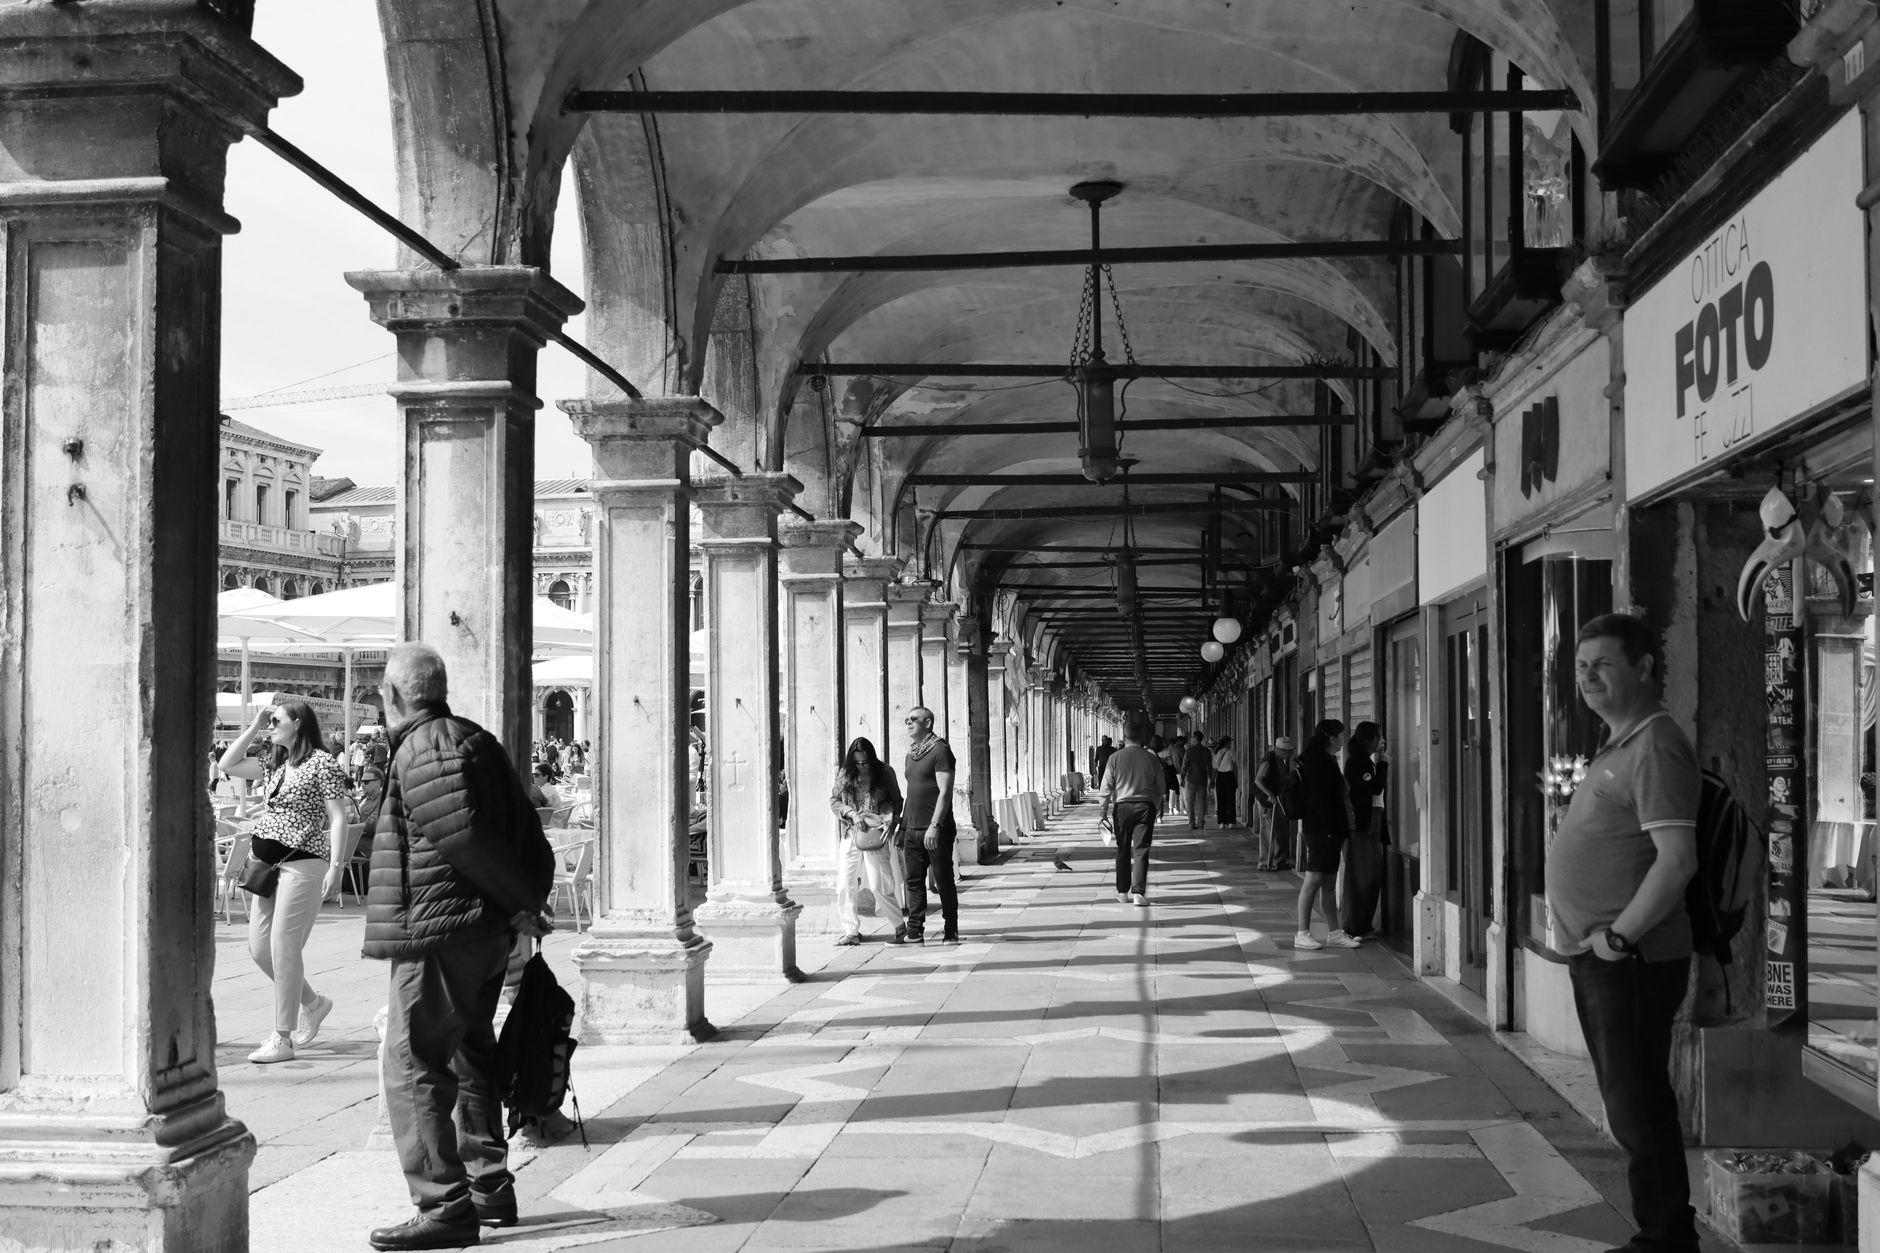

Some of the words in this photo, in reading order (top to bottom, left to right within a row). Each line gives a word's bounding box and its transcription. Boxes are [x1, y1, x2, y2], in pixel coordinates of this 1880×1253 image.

[1691, 214, 1751, 304] OTTICA
[1674, 260, 1775, 420] FOTO
[1766, 654, 1781, 669] EER
[1767, 963, 1791, 983] BNE
[1767, 983, 1792, 995] WAS
[1766, 994, 1793, 1007] HERE
